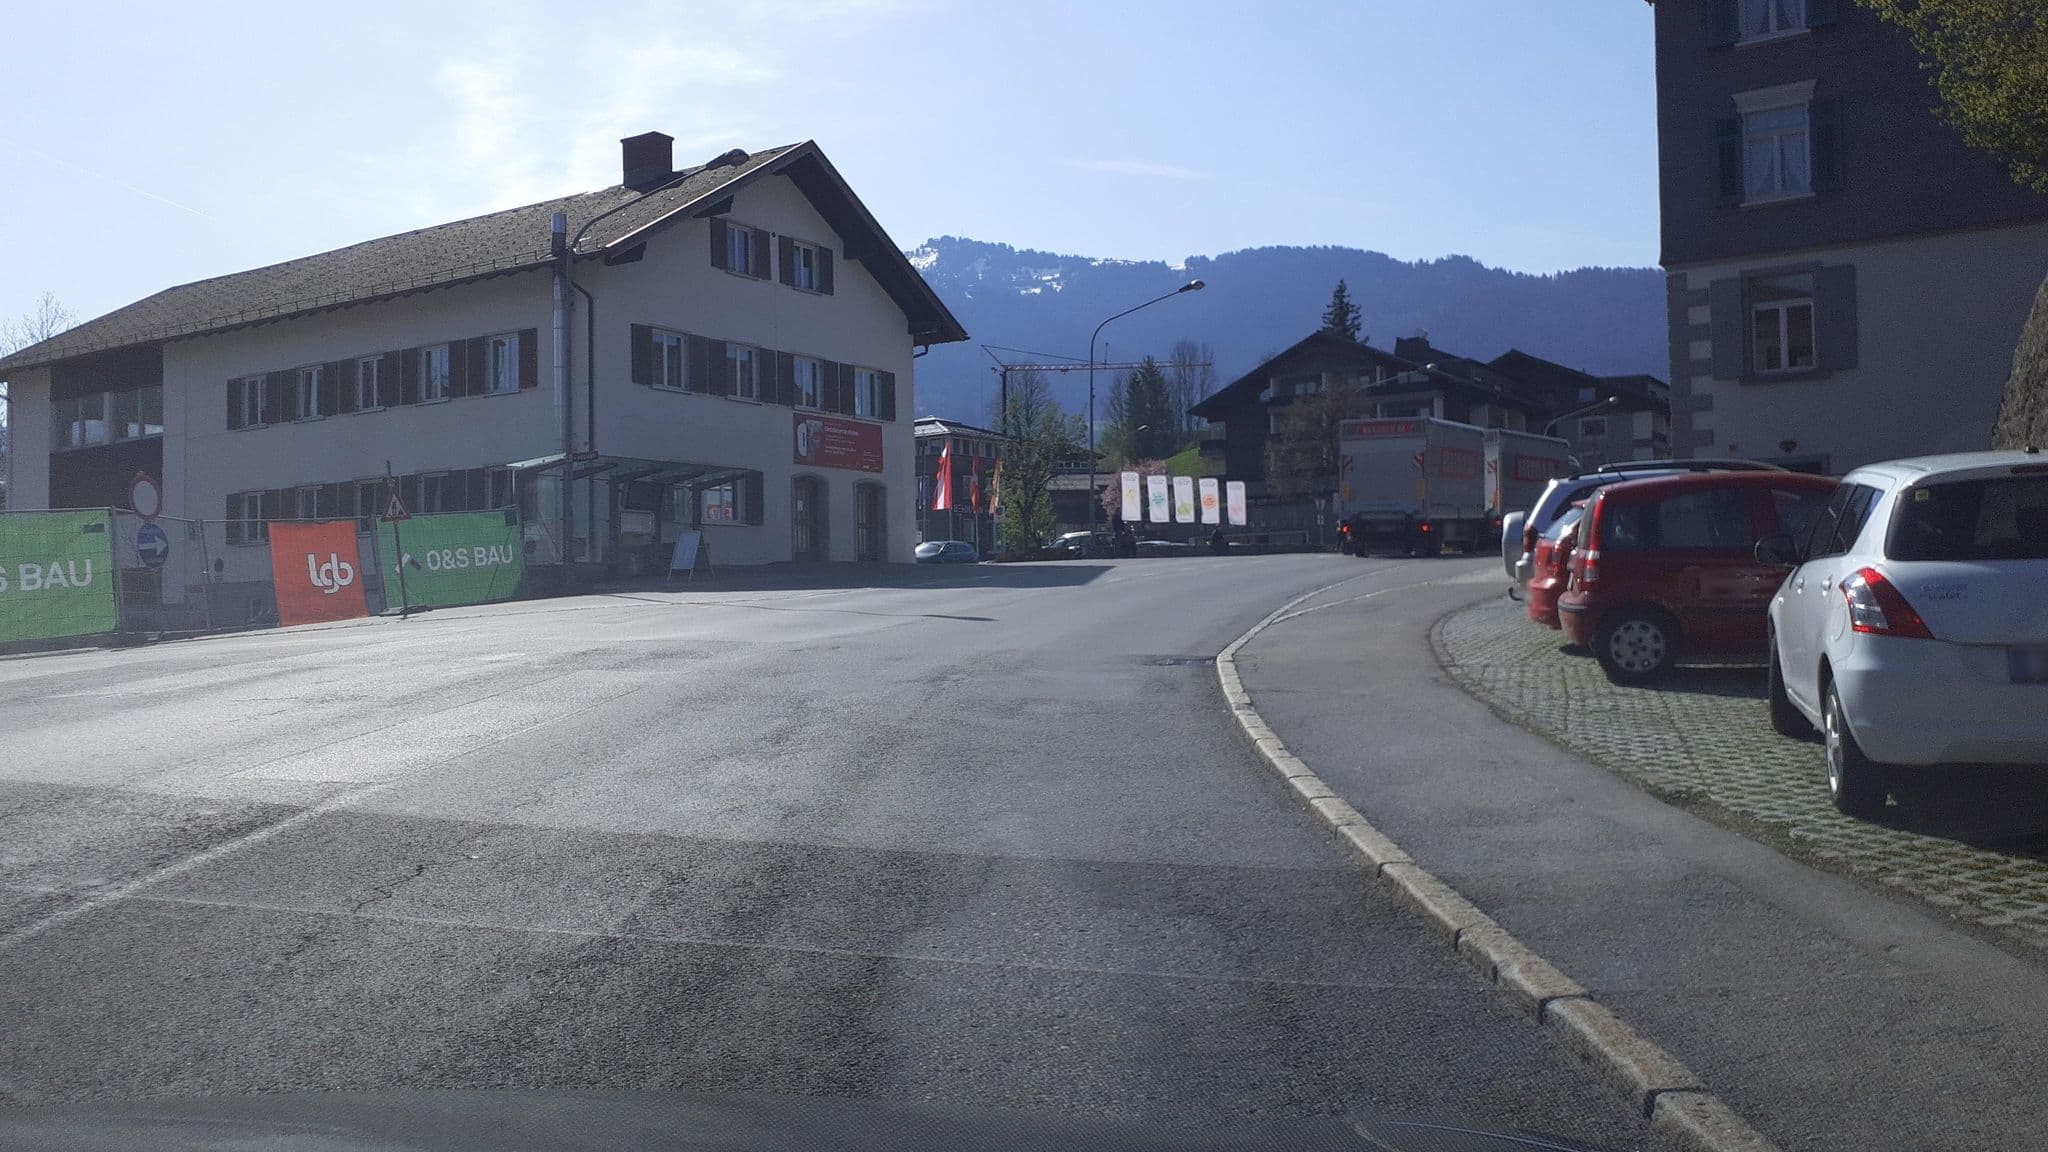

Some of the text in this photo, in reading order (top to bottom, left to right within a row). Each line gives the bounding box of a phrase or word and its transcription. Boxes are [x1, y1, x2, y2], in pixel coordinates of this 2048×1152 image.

[426, 544, 514, 571] O&S BAU
[18, 559, 92, 591] BAU
